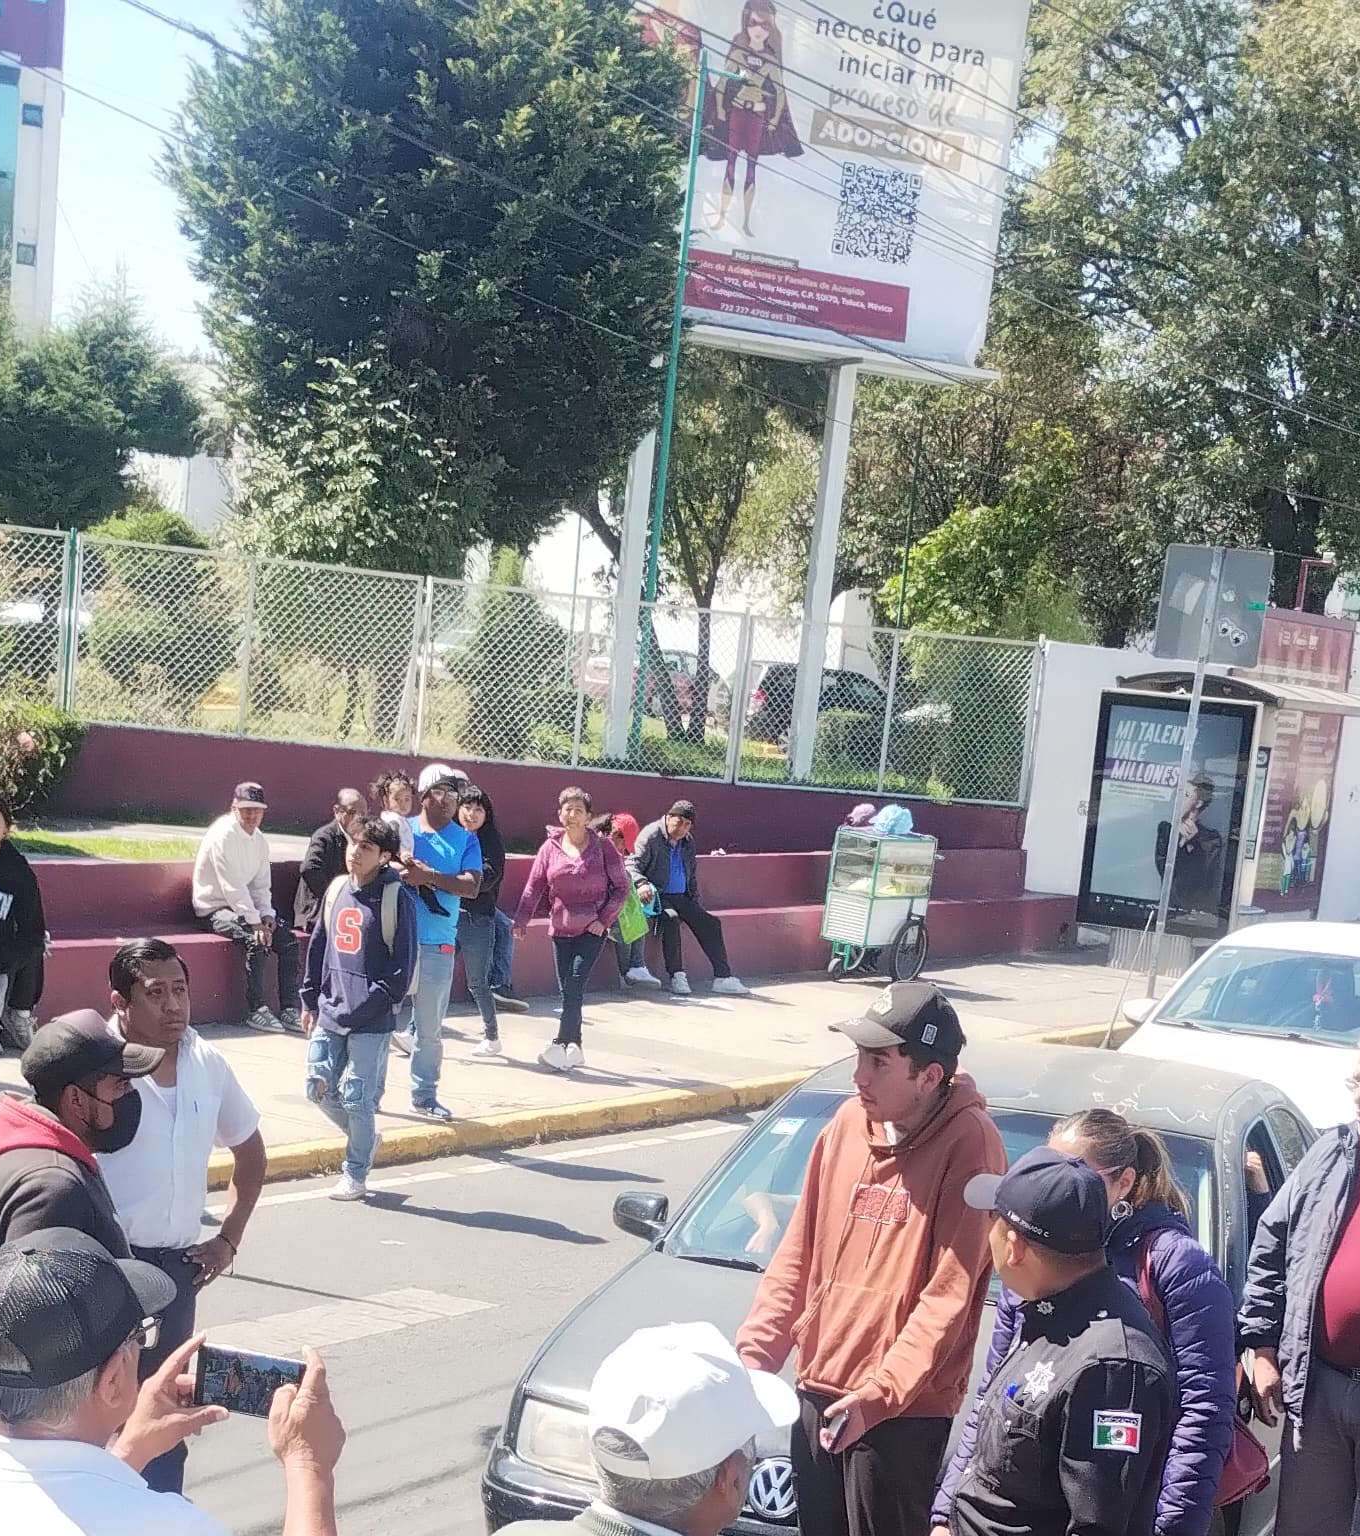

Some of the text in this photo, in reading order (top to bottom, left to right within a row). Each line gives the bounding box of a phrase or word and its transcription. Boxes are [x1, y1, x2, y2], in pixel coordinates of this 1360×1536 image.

[873, 0, 937, 30] ¿Qué
[816, 18, 985, 67] necesito para
[839, 50, 954, 93] iniciar mi
[828, 86, 919, 119] proceso
[1115, 720, 1198, 746] MI TALENT
[1112, 739, 1150, 761] VALE
[1110, 759, 1181, 787] MILLONES
[335, 907, 364, 955] S
